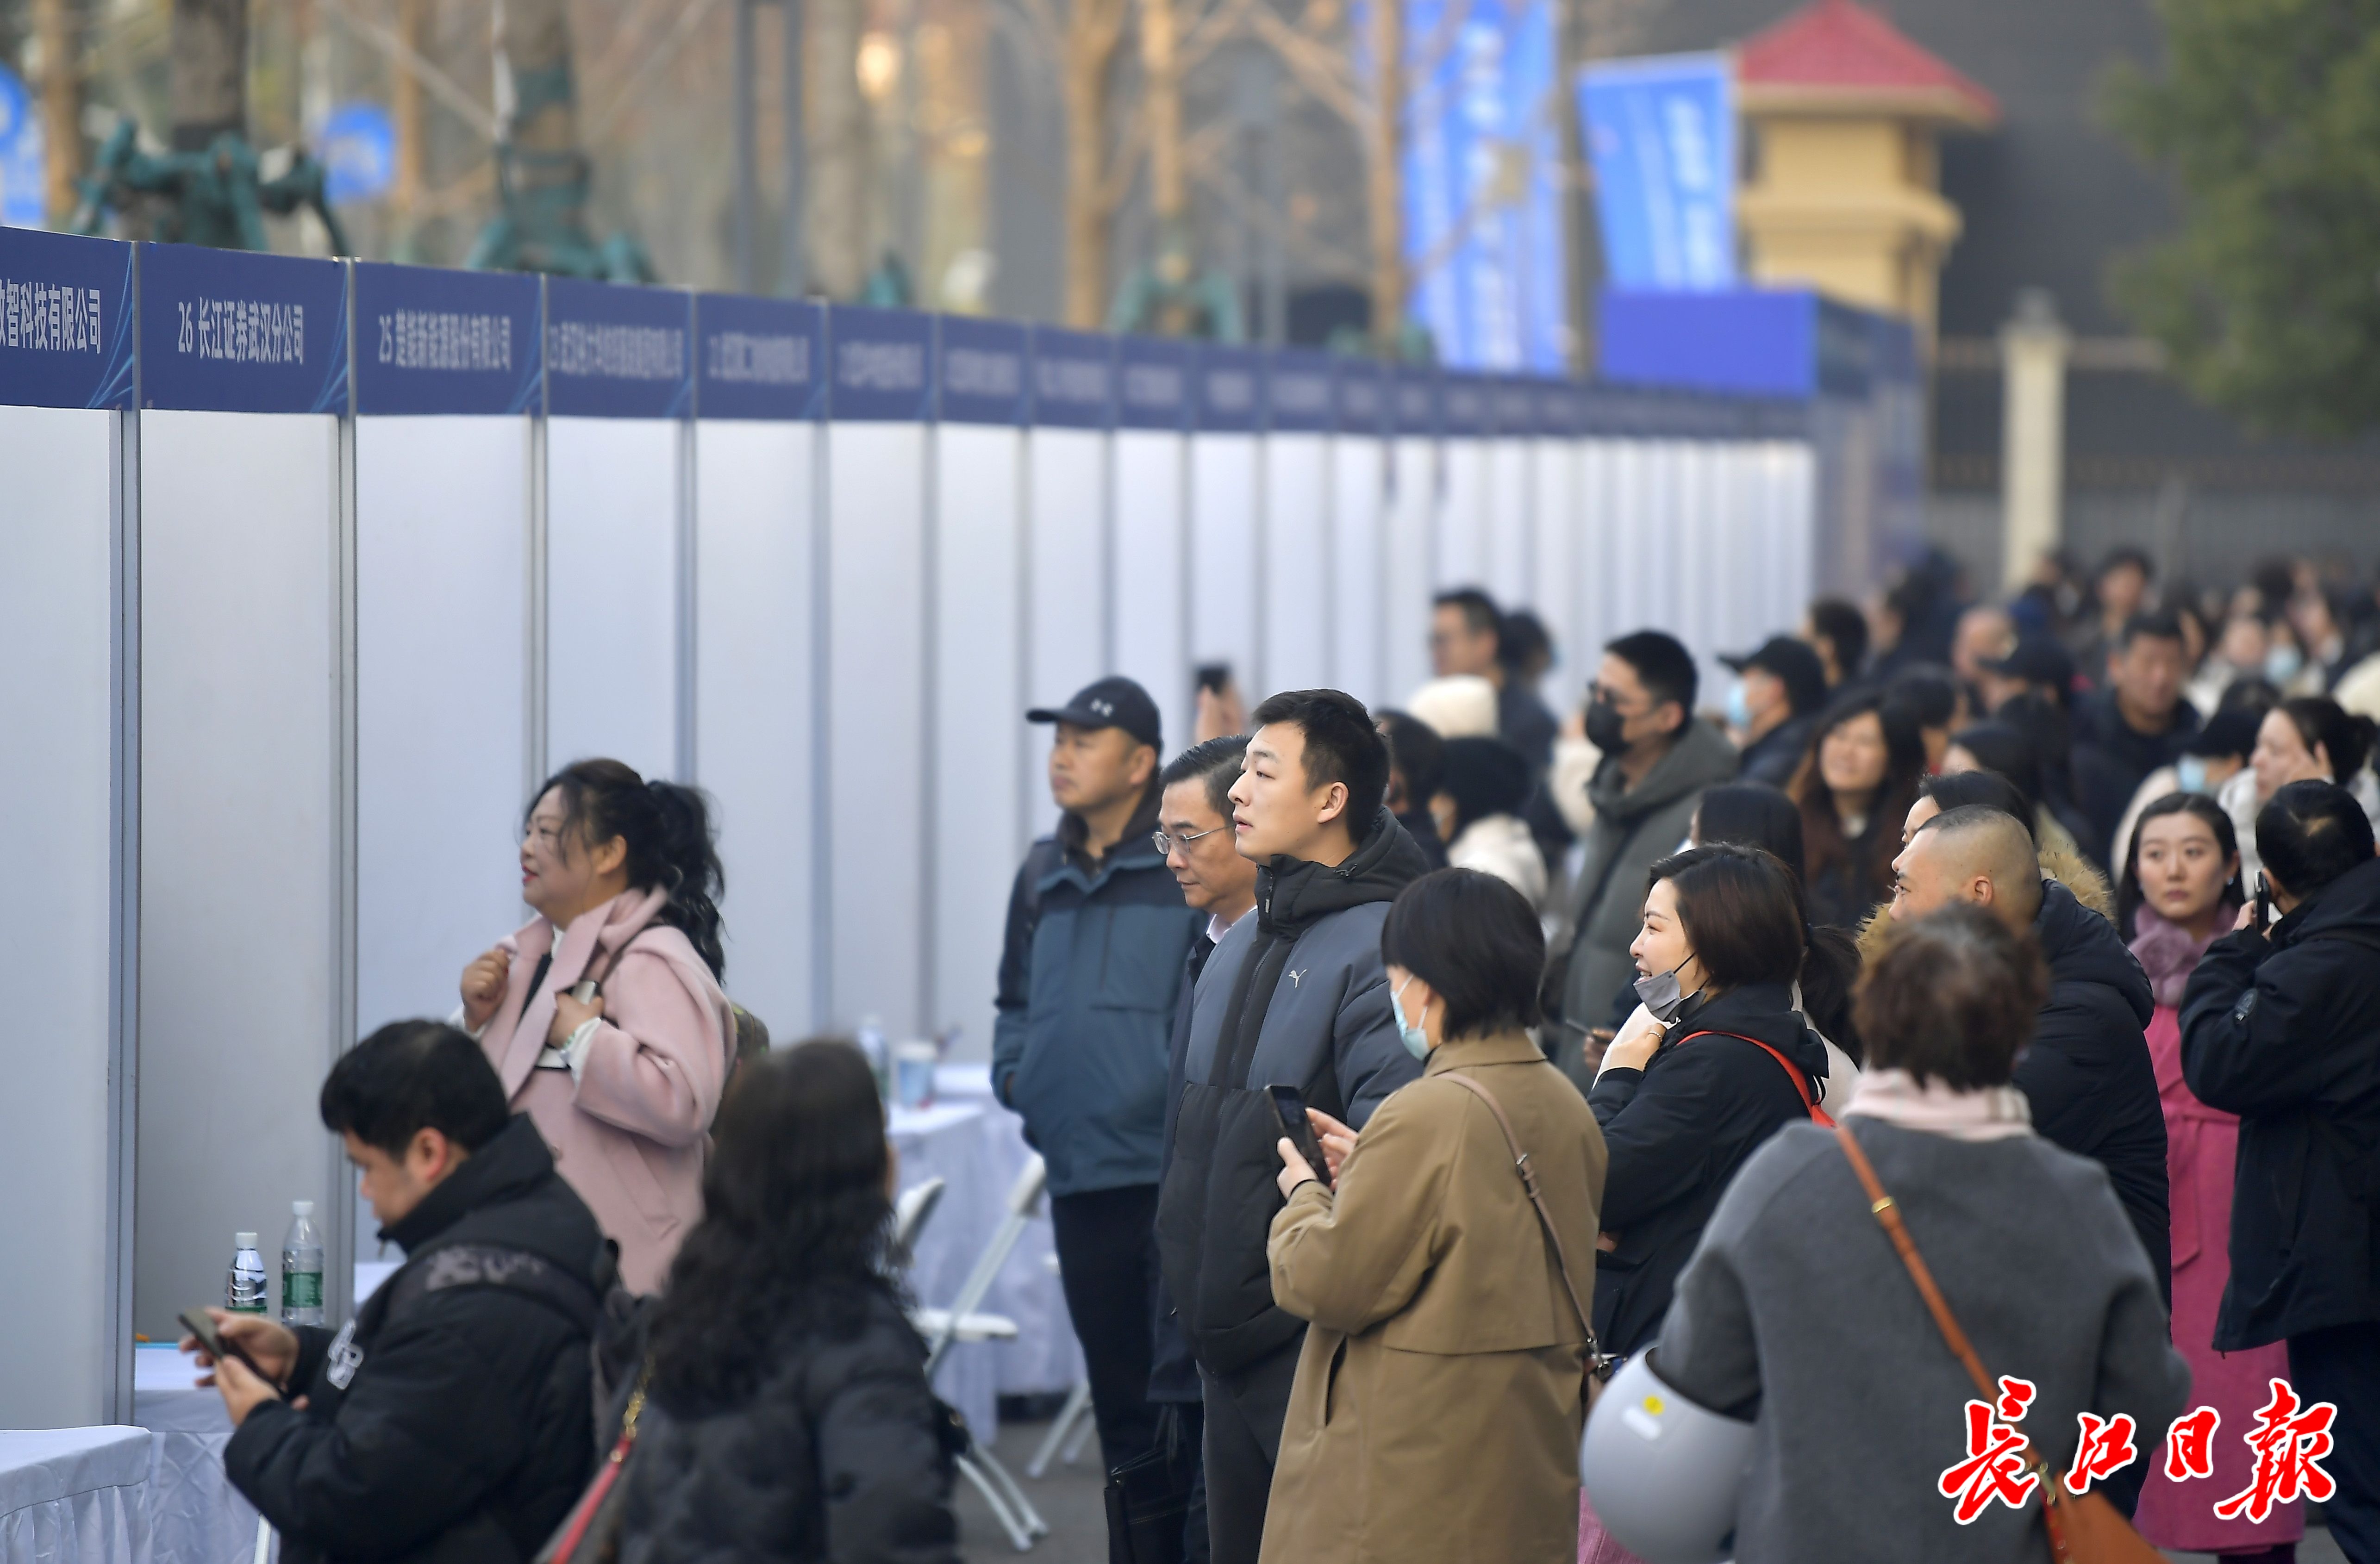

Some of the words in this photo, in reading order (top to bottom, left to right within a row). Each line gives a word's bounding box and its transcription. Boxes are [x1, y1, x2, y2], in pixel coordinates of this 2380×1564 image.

[178, 301, 193, 353] 26
[198, 296, 303, 364] 长江证券武汉分公司
[379, 315, 392, 363] 25
